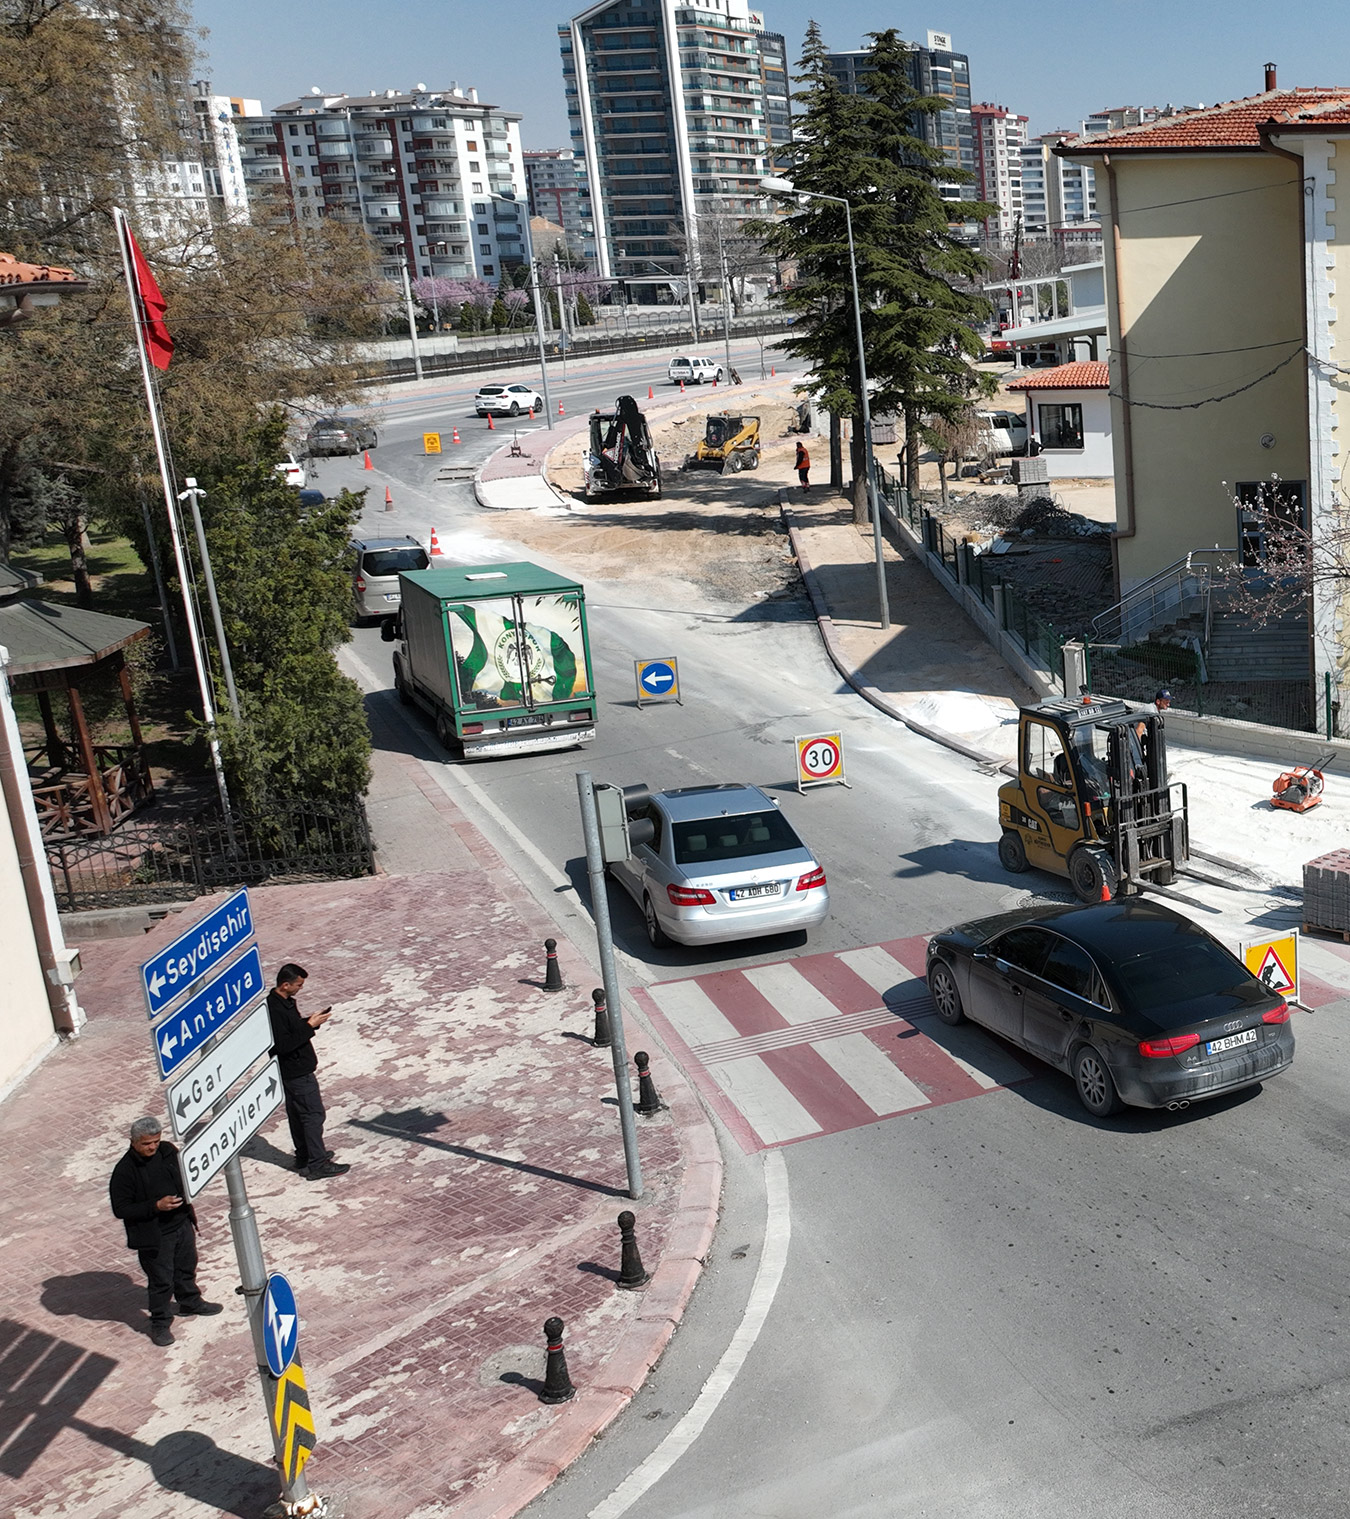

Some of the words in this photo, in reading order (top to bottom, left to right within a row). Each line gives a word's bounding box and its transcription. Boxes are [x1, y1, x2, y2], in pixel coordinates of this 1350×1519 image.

[808, 748, 833, 768] 30
[735, 889, 745, 898] 42
[748, 886, 762, 896] ADH
[764, 884, 779, 894] 680
[166, 907, 248, 985] Seydişehir
[181, 971, 254, 1047] Antalya
[1211, 1040, 1223, 1051] 42
[1224, 1035, 1244, 1049] BHM
[1245, 1030, 1256, 1042] 42
[192, 1064, 223, 1104] Gar
[188, 1093, 262, 1182] Sanayiler
